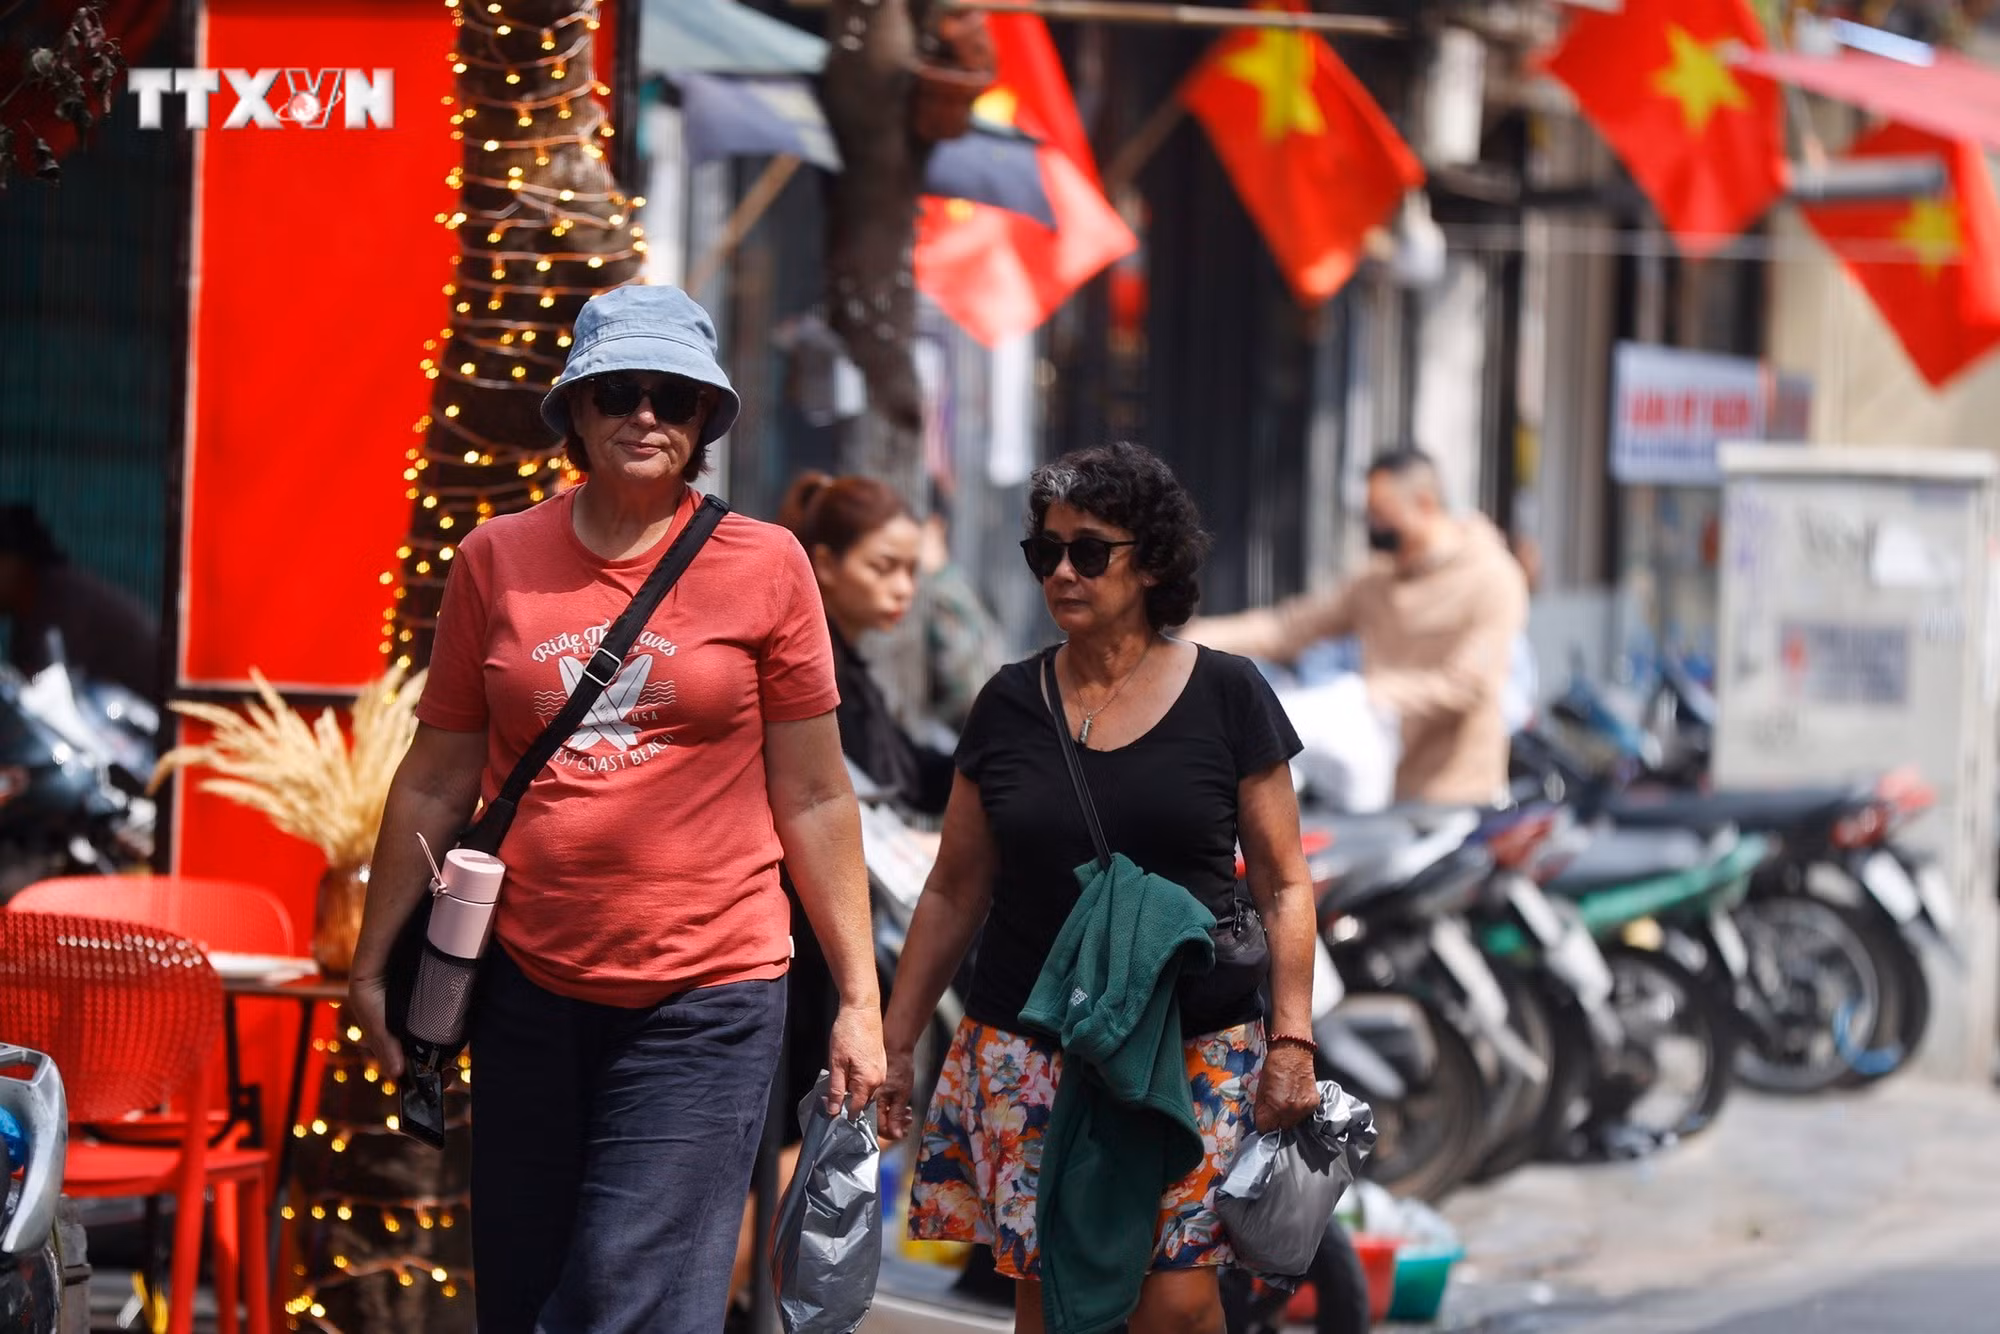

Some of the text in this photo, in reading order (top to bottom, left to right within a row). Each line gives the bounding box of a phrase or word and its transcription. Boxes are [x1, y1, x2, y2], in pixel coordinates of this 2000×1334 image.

[531, 618, 678, 663] Ride Th aves
[631, 710, 658, 722] USA
[553, 733, 674, 772] EST COAST BEACH
